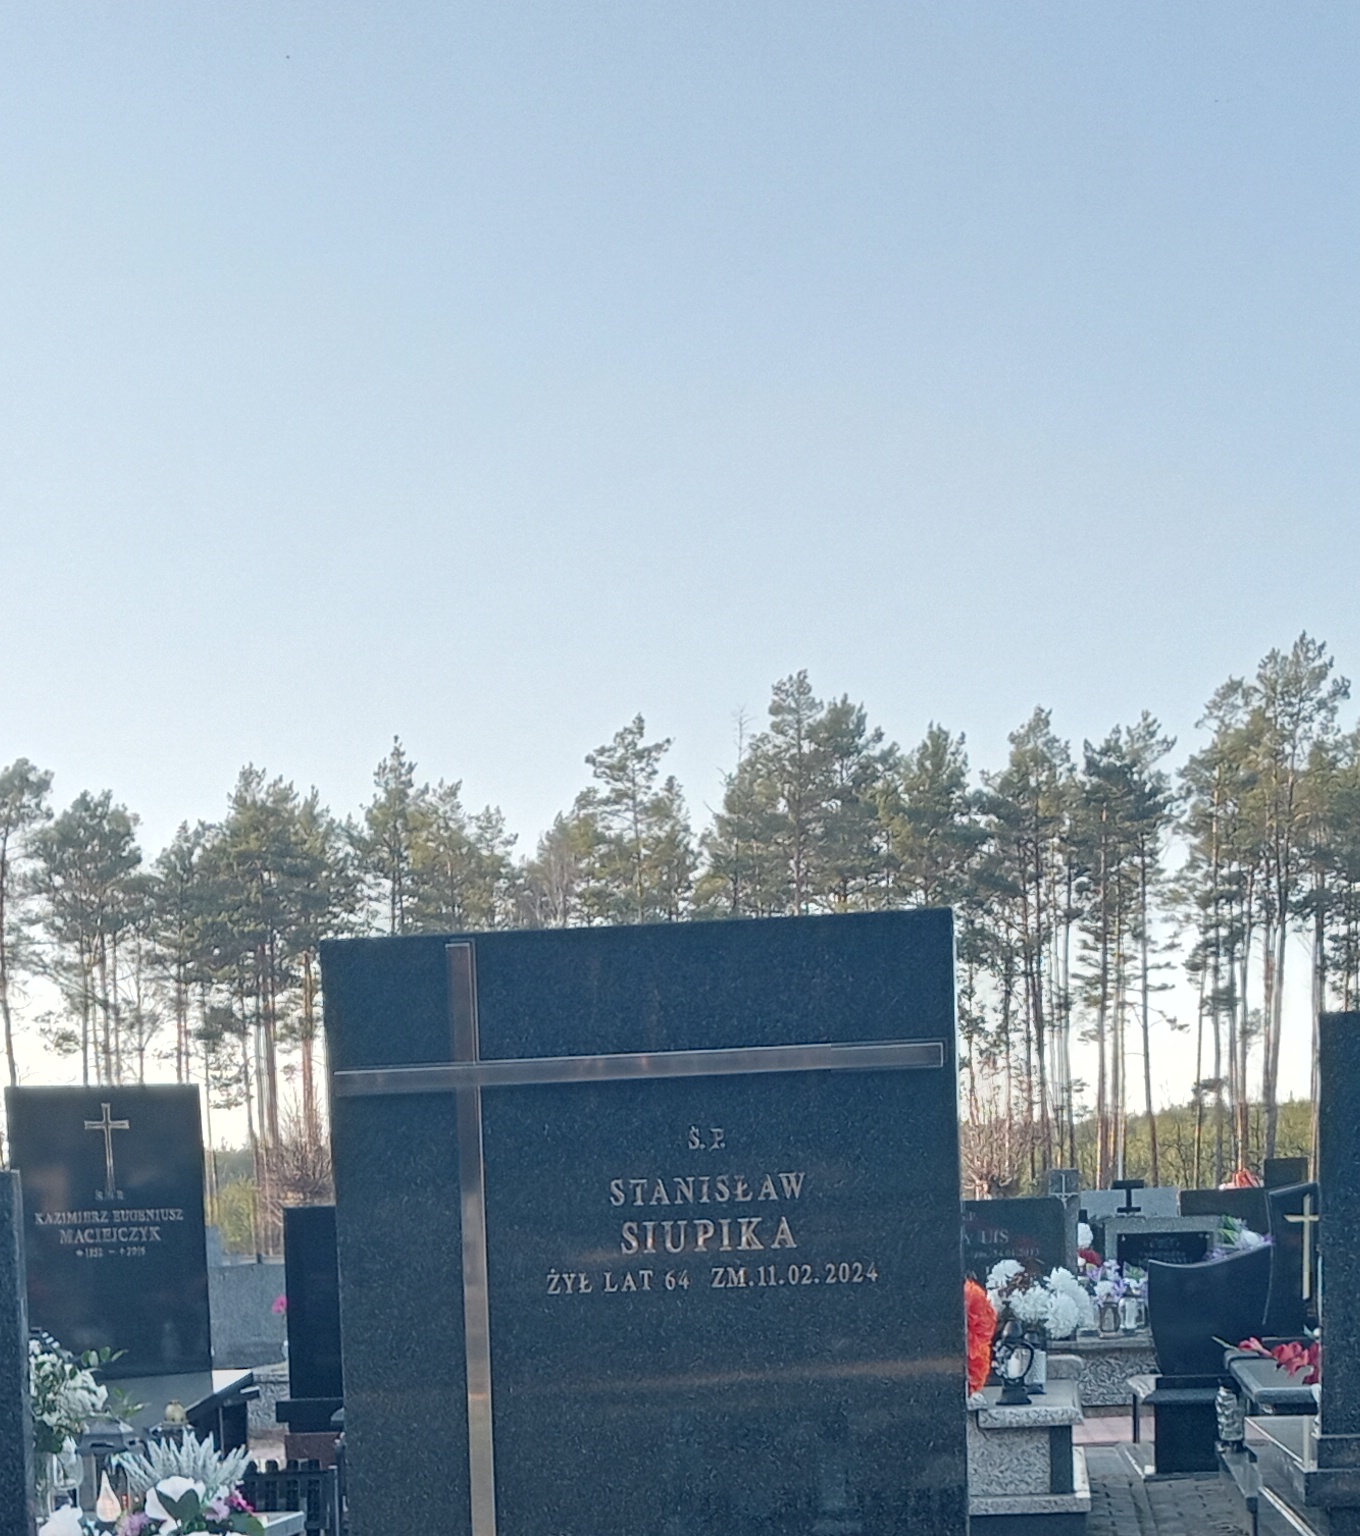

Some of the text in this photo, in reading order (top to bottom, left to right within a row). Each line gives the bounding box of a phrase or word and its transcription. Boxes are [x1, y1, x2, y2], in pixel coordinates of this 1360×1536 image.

[609, 1171, 806, 1207] STANISŁAW
[34, 1208, 184, 1225] KAZIMIERZ EUGENIUSZ
[58, 1226, 162, 1245] MACIEJCZYK
[620, 1216, 797, 1255] SIUPIKA
[546, 1268, 593, 1295] ŻYŁ
[603, 1270, 653, 1293] LAT
[664, 1269, 691, 1291] 64
